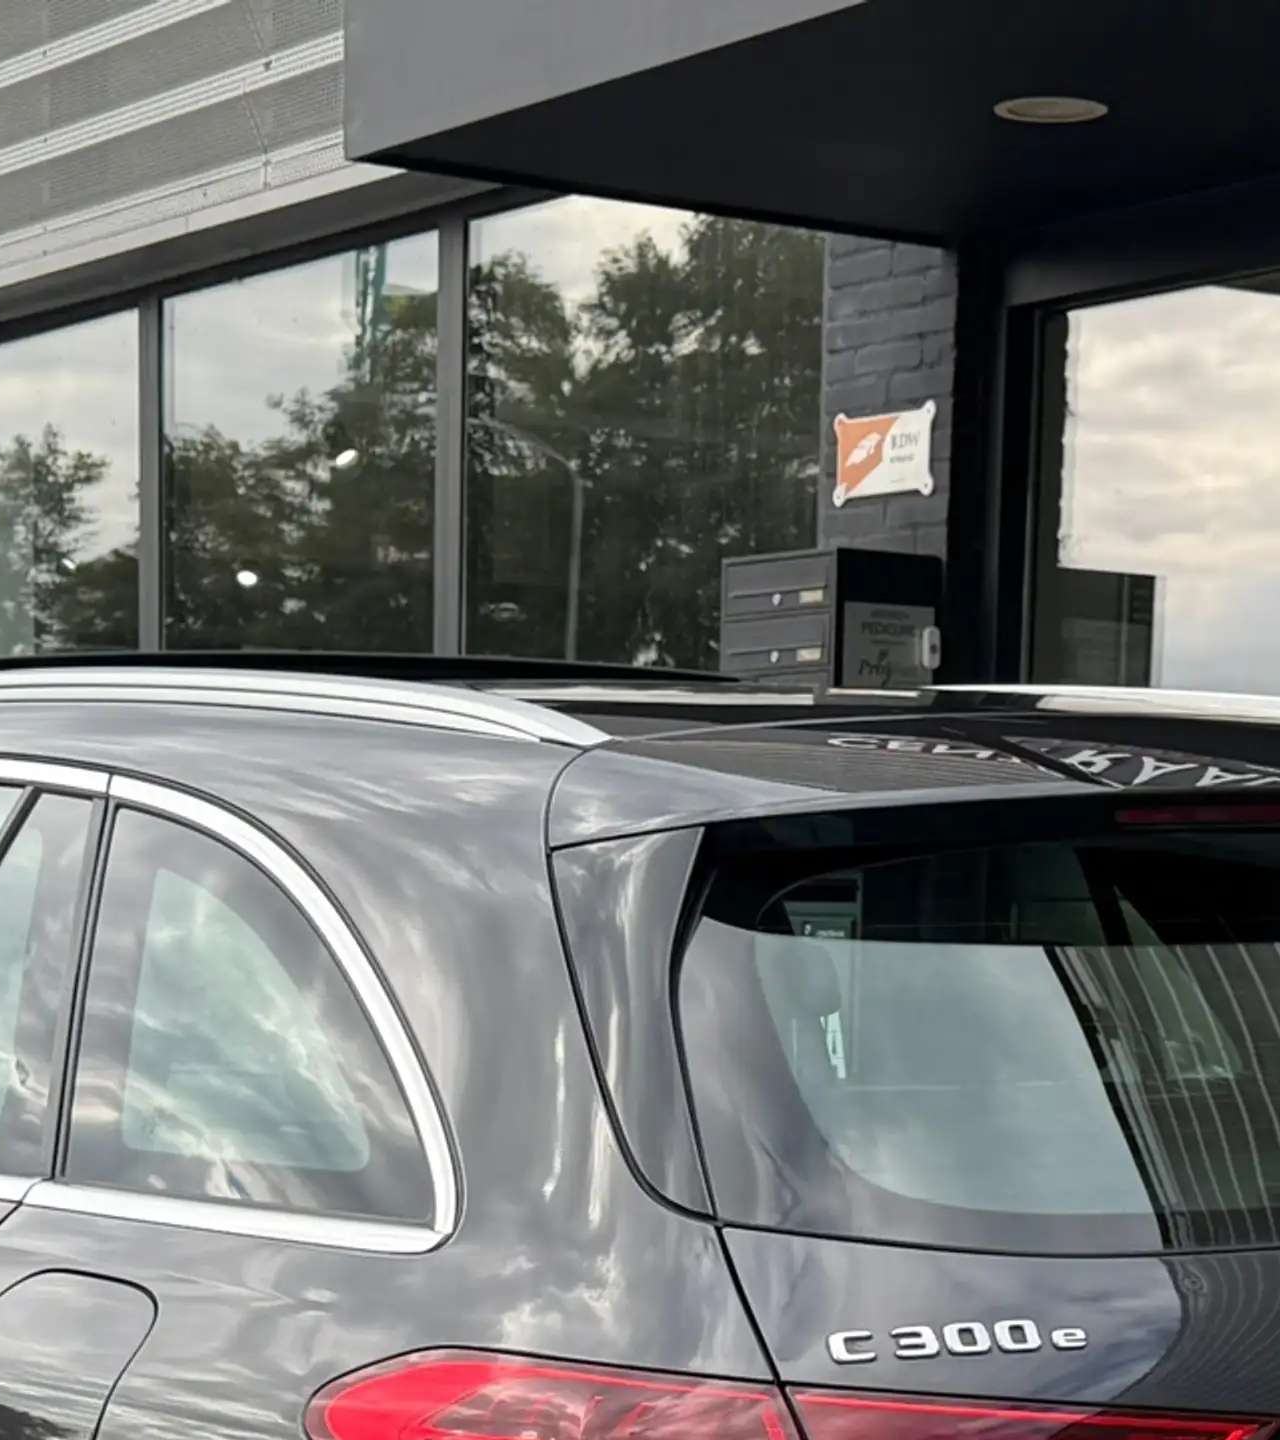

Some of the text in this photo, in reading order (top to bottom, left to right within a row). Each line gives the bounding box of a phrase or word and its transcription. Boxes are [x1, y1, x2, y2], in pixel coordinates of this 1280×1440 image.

[827, 1318, 1088, 1363] C 300 e
